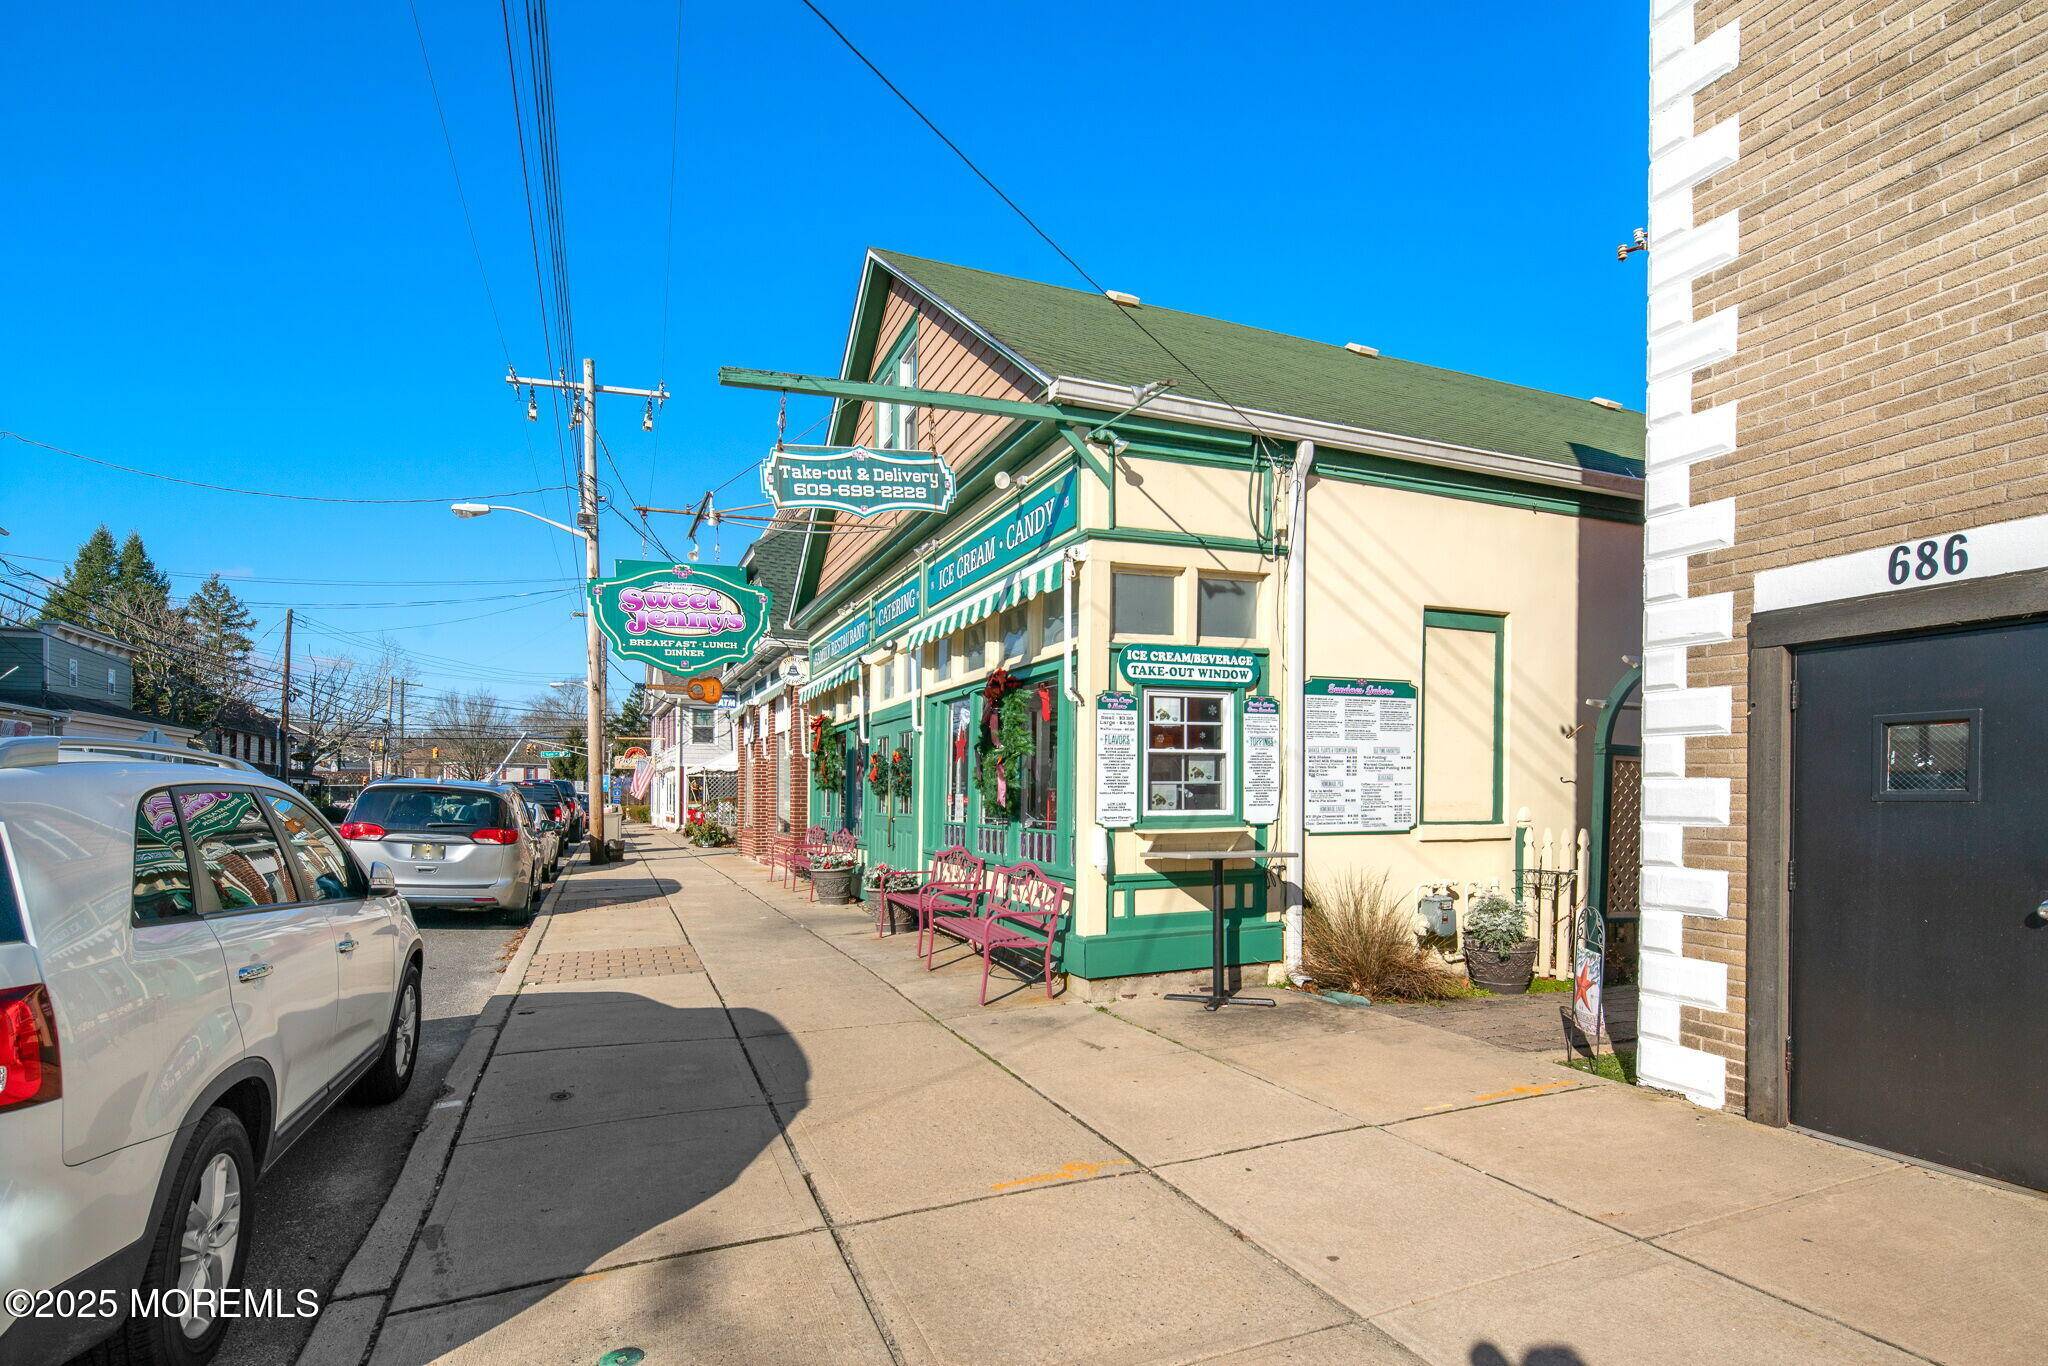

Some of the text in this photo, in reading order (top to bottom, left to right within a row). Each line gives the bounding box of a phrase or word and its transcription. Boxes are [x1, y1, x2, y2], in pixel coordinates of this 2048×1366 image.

[779, 464, 939, 488] Take-out & Delivery
[793, 483, 927, 499] 609-698-2228
[938, 497, 1055, 591] ICE CREAM CANDY
[1887, 533, 1968, 586] 686
[618, 587, 722, 612] Sweet
[878, 588, 916, 627] CATERING
[625, 610, 746, 636] Jenny's
[629, 638, 738, 649] BREAKFAST LUNCH
[831, 621, 867, 657] RESTAURANT
[664, 648, 705, 657] DINNER
[1126, 650, 1254, 666] ICE CREAM/BEVERAGE
[1130, 665, 1250, 680] TAKE-OUT WINDOW
[718, 699, 736, 708] ATM
[1104, 734, 1131, 745] FLAVORS
